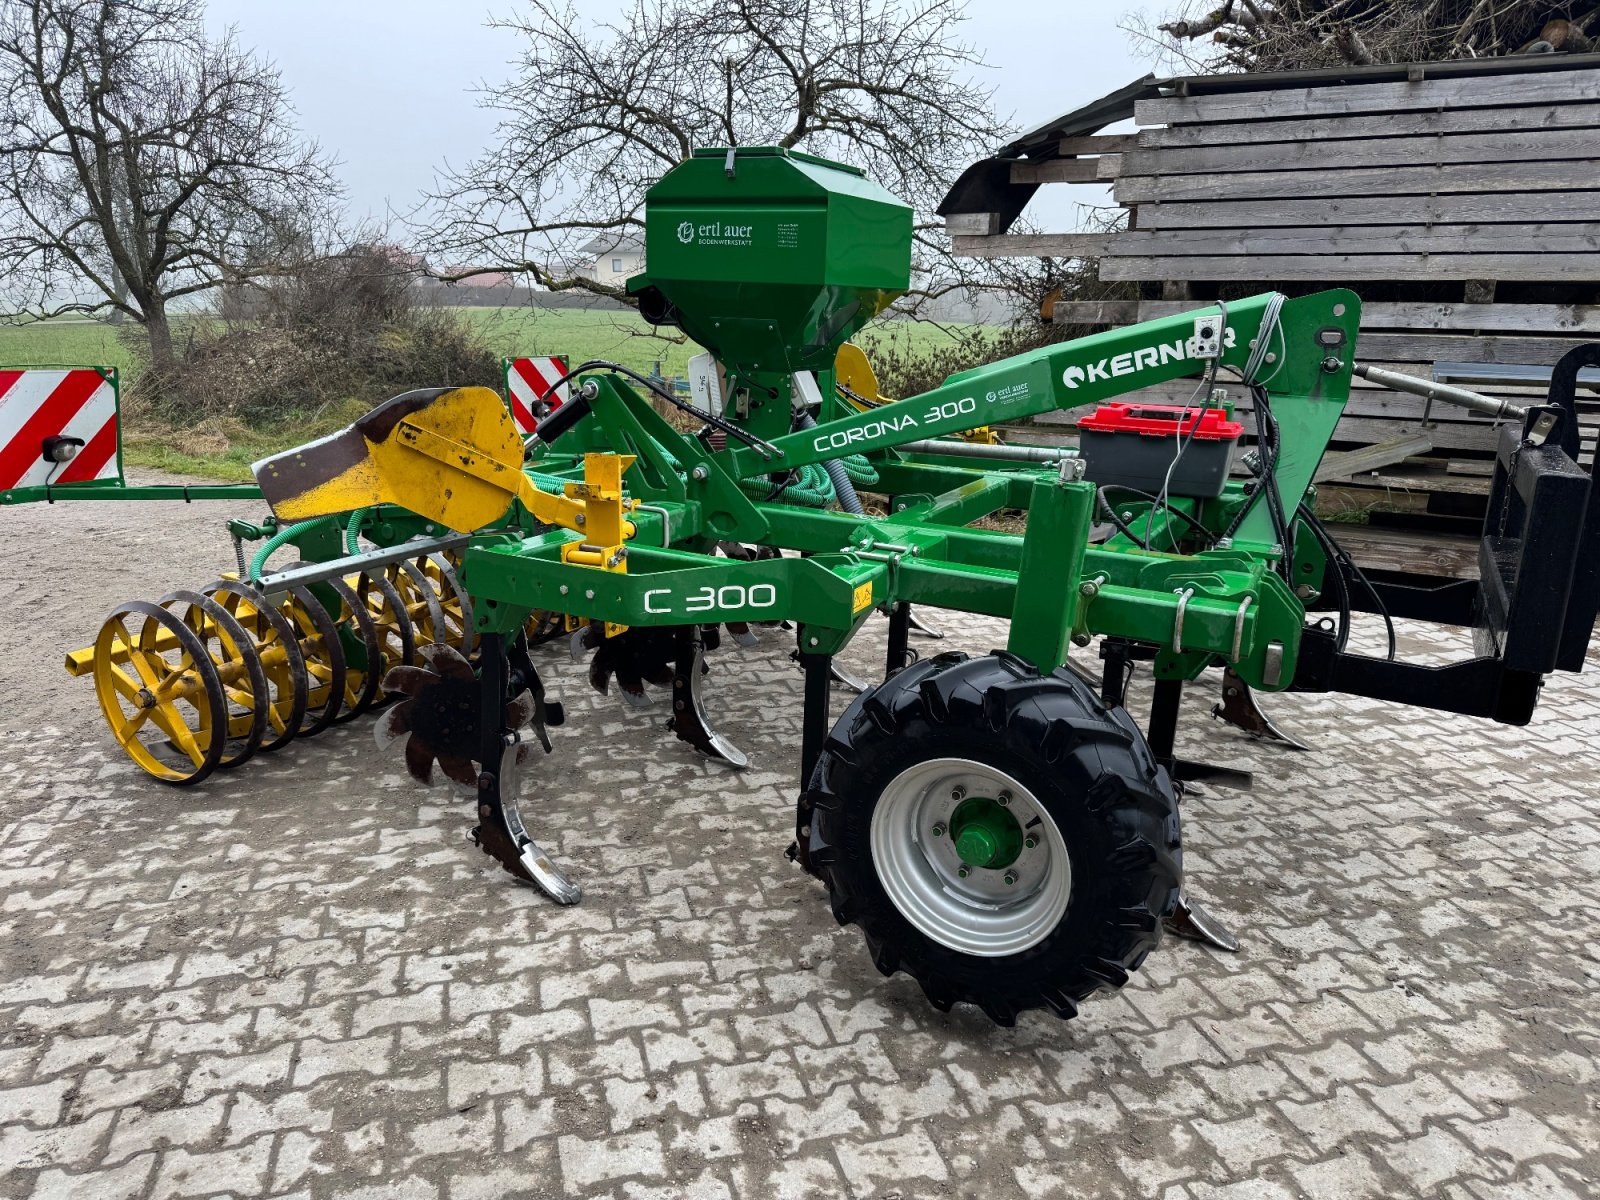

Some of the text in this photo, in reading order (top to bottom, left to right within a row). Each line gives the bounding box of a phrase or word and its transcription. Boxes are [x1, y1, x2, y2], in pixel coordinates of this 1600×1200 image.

[698, 221, 753, 238] ertl auer
[698, 238, 753, 246] BODENWERKSTATT
[814, 397, 976, 452] CORONA 300
[644, 584, 776, 613] C 300
